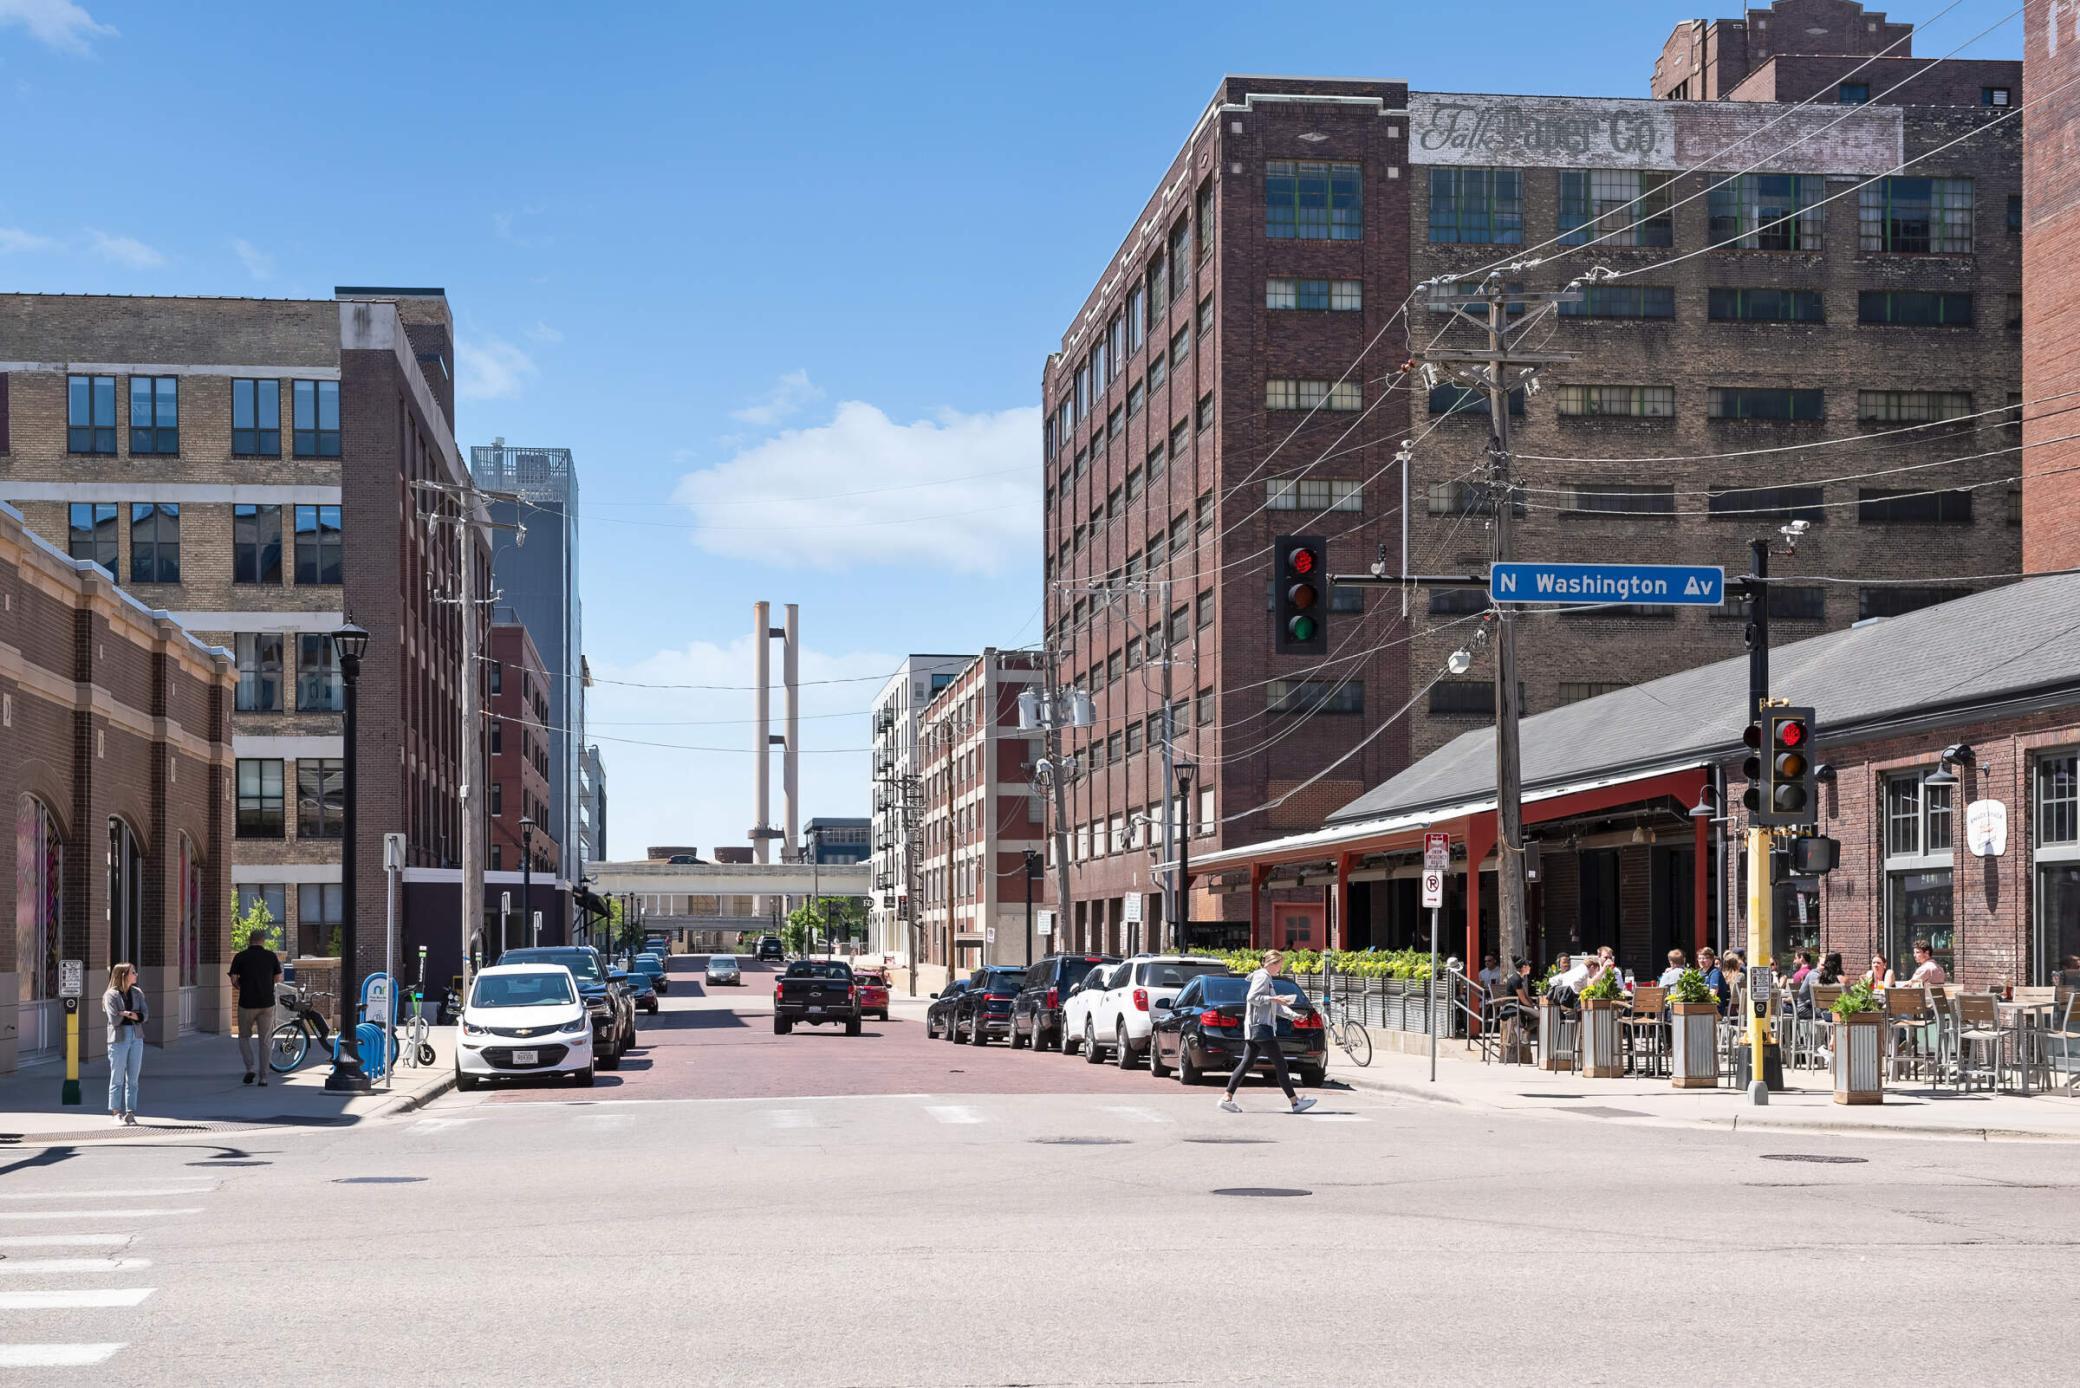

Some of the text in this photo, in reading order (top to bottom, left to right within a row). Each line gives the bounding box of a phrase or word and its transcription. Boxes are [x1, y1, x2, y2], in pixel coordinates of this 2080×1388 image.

[1501, 573, 1713, 600] N Washington Av
